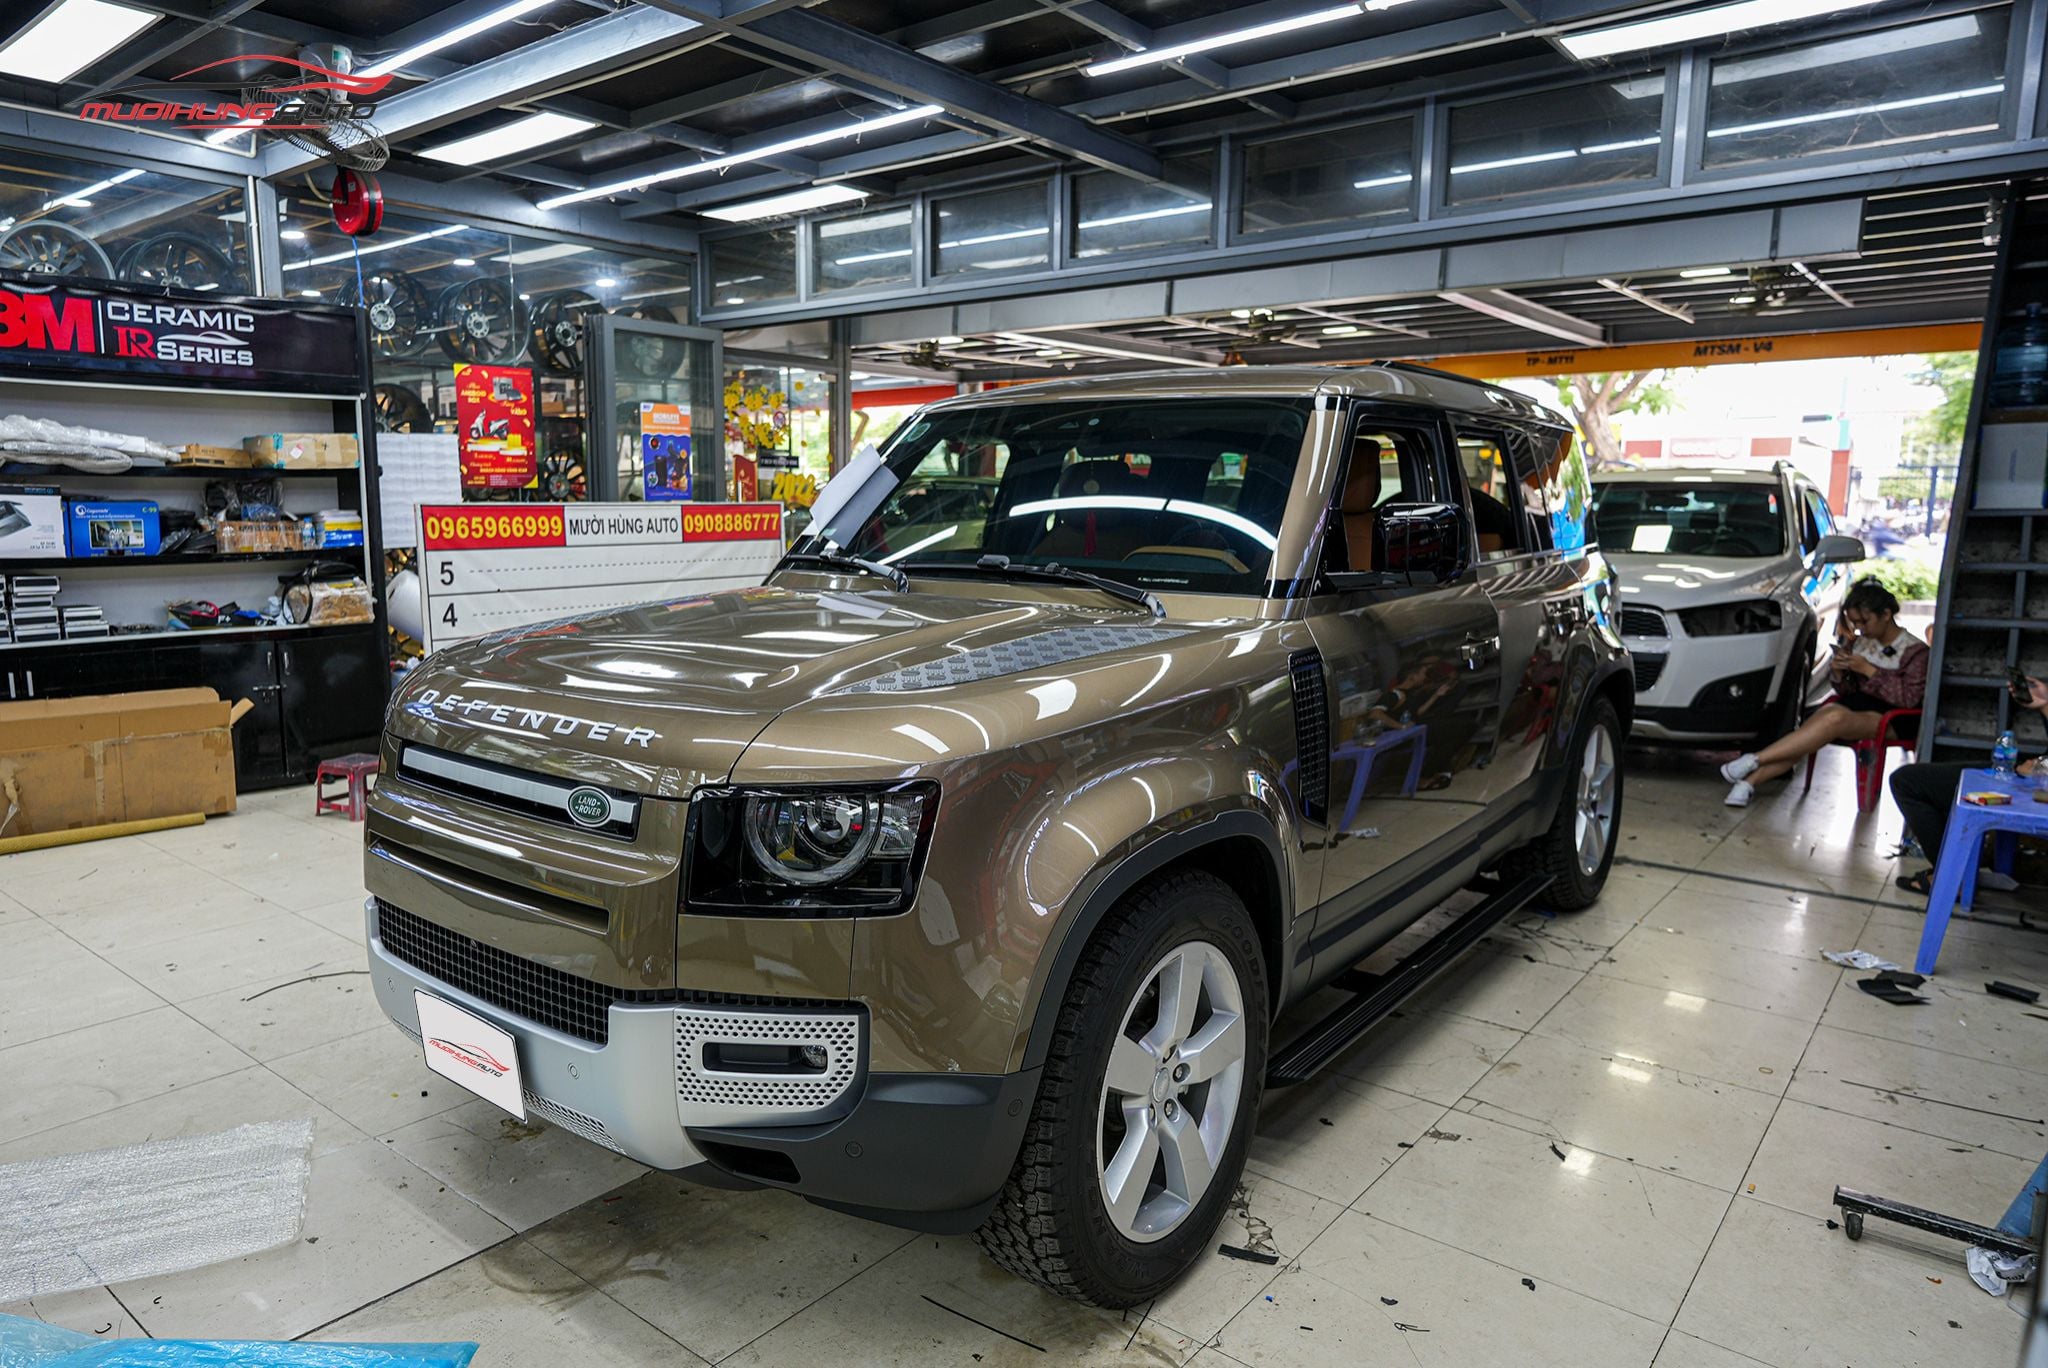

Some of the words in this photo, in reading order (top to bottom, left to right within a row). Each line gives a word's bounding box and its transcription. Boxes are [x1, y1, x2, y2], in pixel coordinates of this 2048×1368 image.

[107, 302, 256, 332] CERAMIC
[157, 341, 254, 366] SERIES
[772, 471, 816, 504] 2022
[426, 515, 563, 540] 0965966999
[569, 516, 605, 535] MƯỜI
[608, 515, 644, 534] HÙNG
[646, 514, 679, 533] AUTO
[684, 512, 780, 533] 0908886777
[440, 562, 454, 585] 5
[442, 602, 458, 627] 4
[418, 689, 657, 749] DEFENDER
